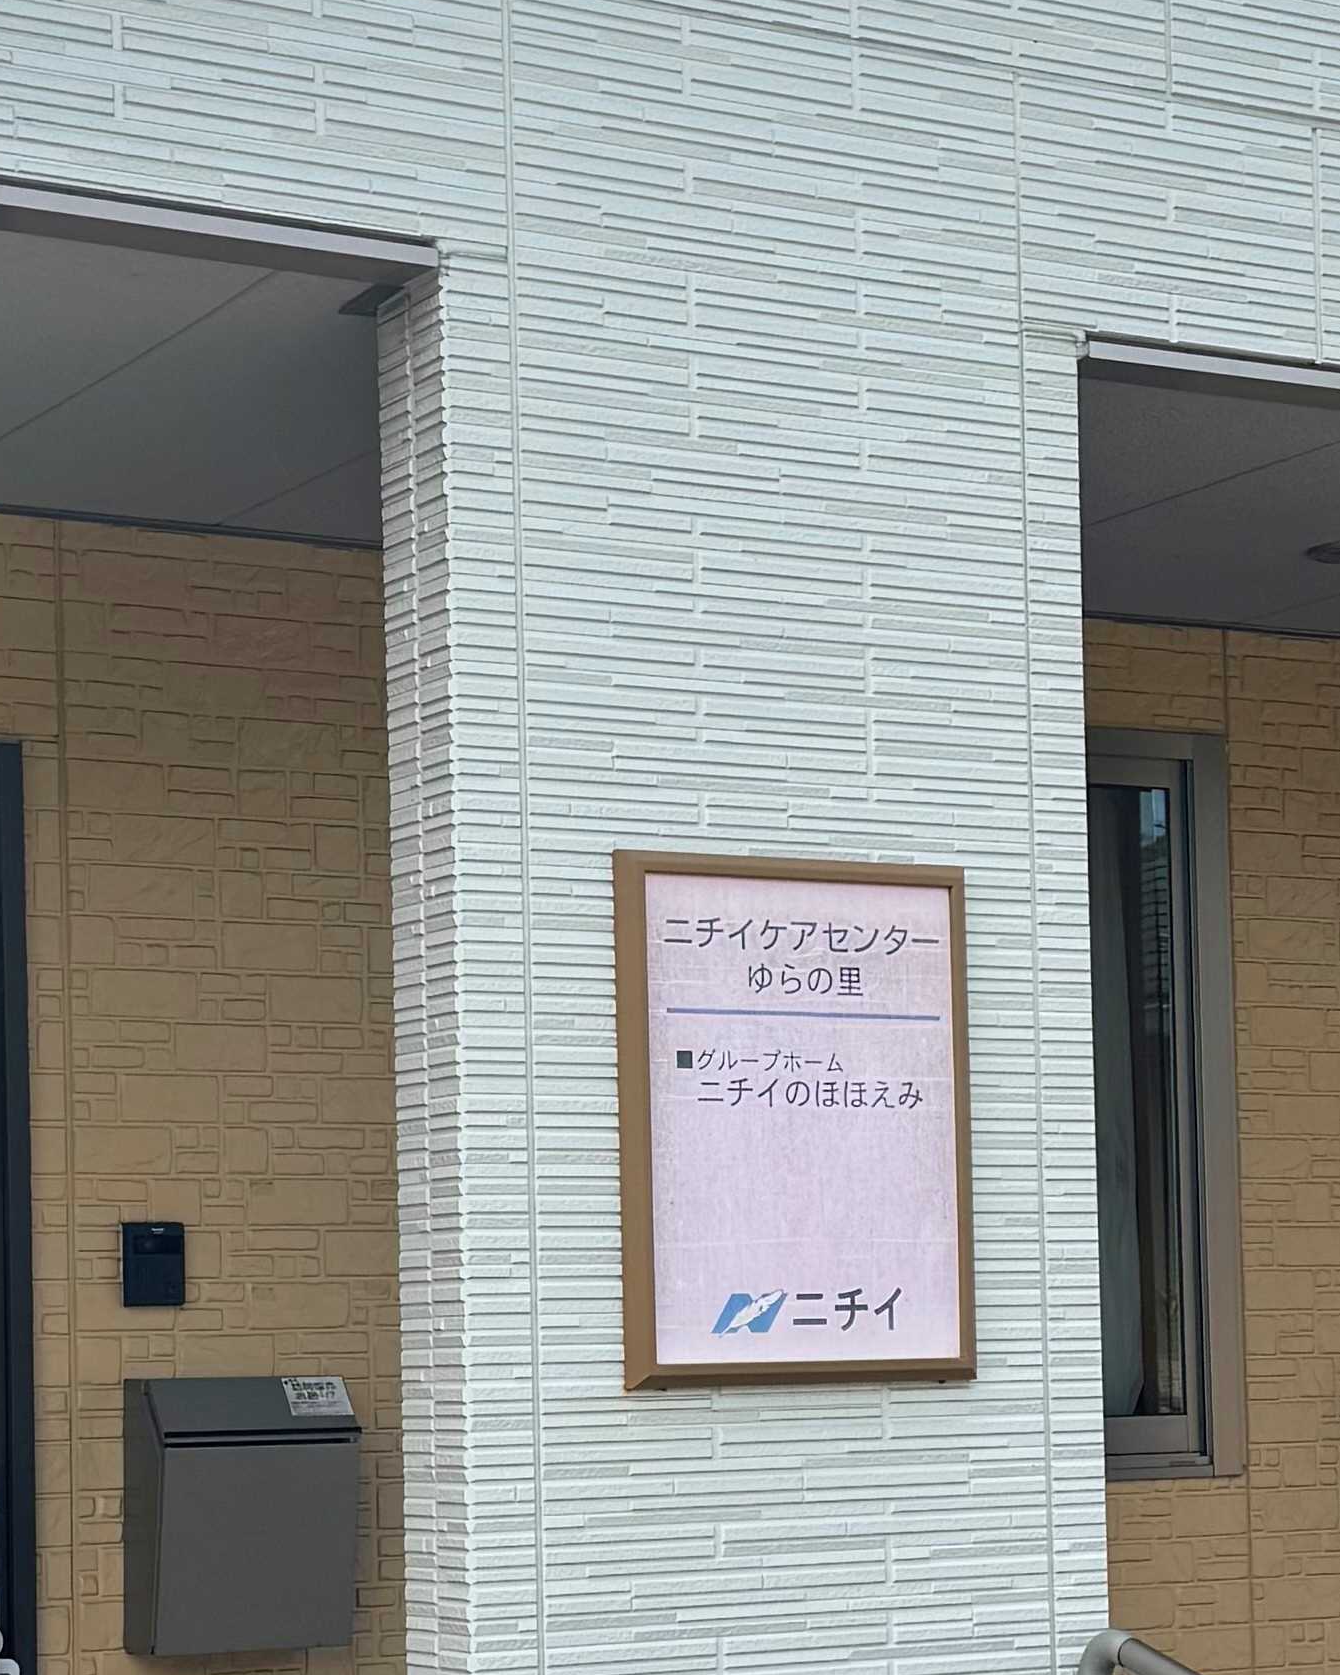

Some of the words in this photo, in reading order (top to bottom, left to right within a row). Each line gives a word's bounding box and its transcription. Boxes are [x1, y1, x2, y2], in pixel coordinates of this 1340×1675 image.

[663, 916, 940, 956] ニチイケアセンター
[748, 963, 864, 997] ゆらの里
[697, 1049, 844, 1073] グループホーム
[696, 1077, 924, 1109] ニチイのほほえみ
[792, 1286, 903, 1332] ニチイ
